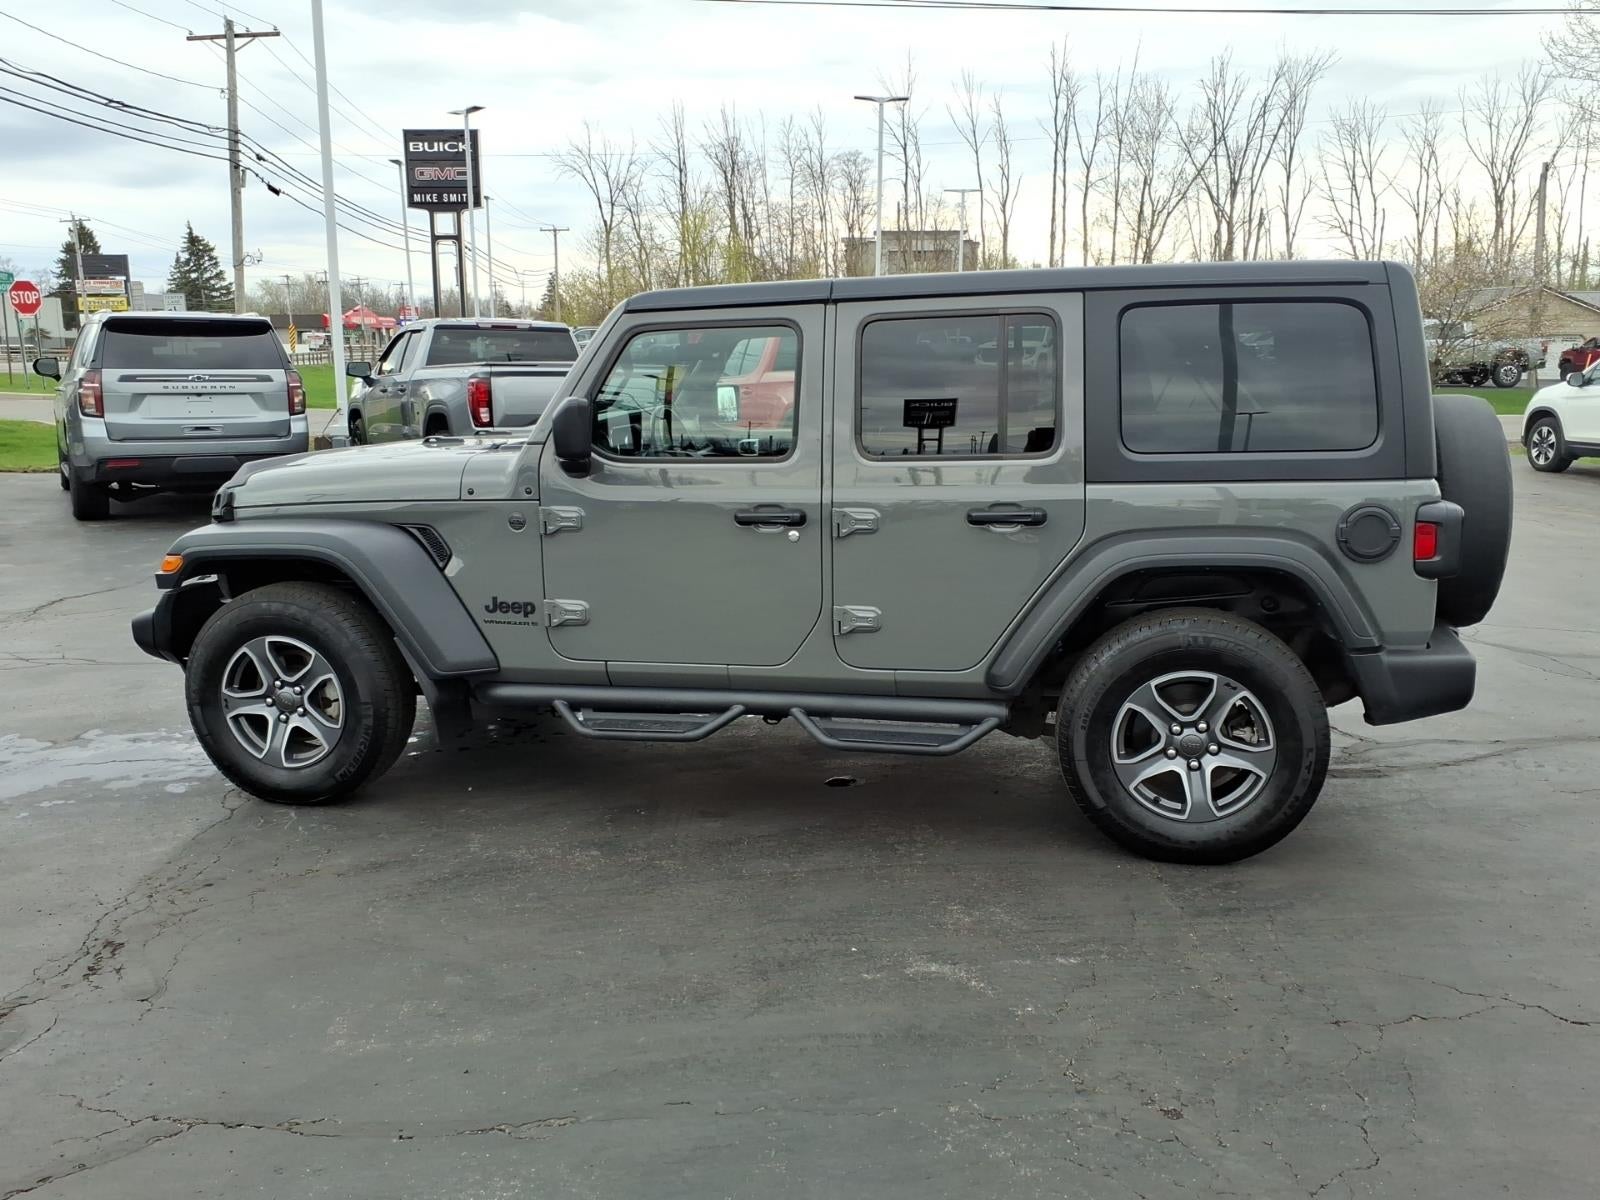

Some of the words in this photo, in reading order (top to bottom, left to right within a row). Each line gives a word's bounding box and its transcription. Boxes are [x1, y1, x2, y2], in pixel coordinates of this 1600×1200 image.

[409, 141, 473, 152] BUICK
[415, 167, 469, 180] GMC
[413, 193, 438, 202] MIKE
[442, 193, 468, 203] SMIT
[11, 291, 39, 304] STOP
[484, 596, 536, 618] Jeep
